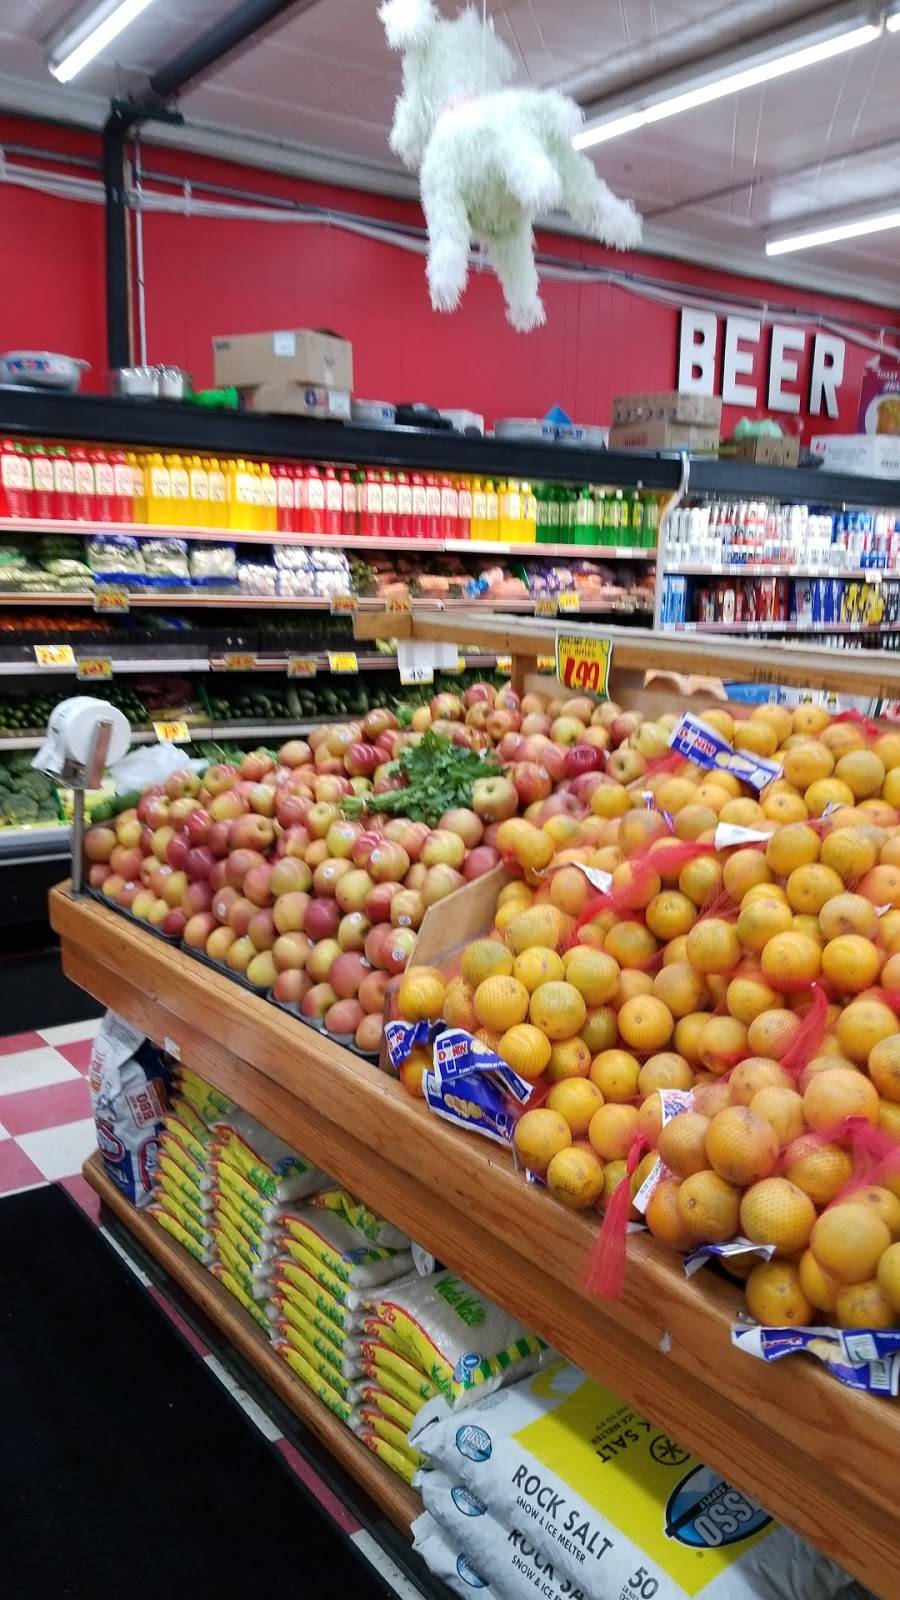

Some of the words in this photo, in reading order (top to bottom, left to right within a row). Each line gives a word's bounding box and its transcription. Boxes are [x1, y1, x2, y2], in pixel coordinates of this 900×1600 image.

[679, 306, 846, 419] BEER
[680, 729, 716, 756] DNDY
[438, 1040, 468, 1061] DNDY
[460, 1426, 491, 1451] RUSSO
[596, 1429, 640, 1463] SALT
[512, 1464, 566, 1519] ROCK
[563, 1510, 615, 1560] SALT
[516, 1496, 539, 1519] SNOW
[545, 1521, 558, 1538] ICE
[557, 1533, 586, 1565] MELTER
[512, 1555, 536, 1580] SNOW
[534, 1577, 541, 1587] &
[541, 1583, 555, 1599] ICE
[628, 1566, 659, 1599] 50
